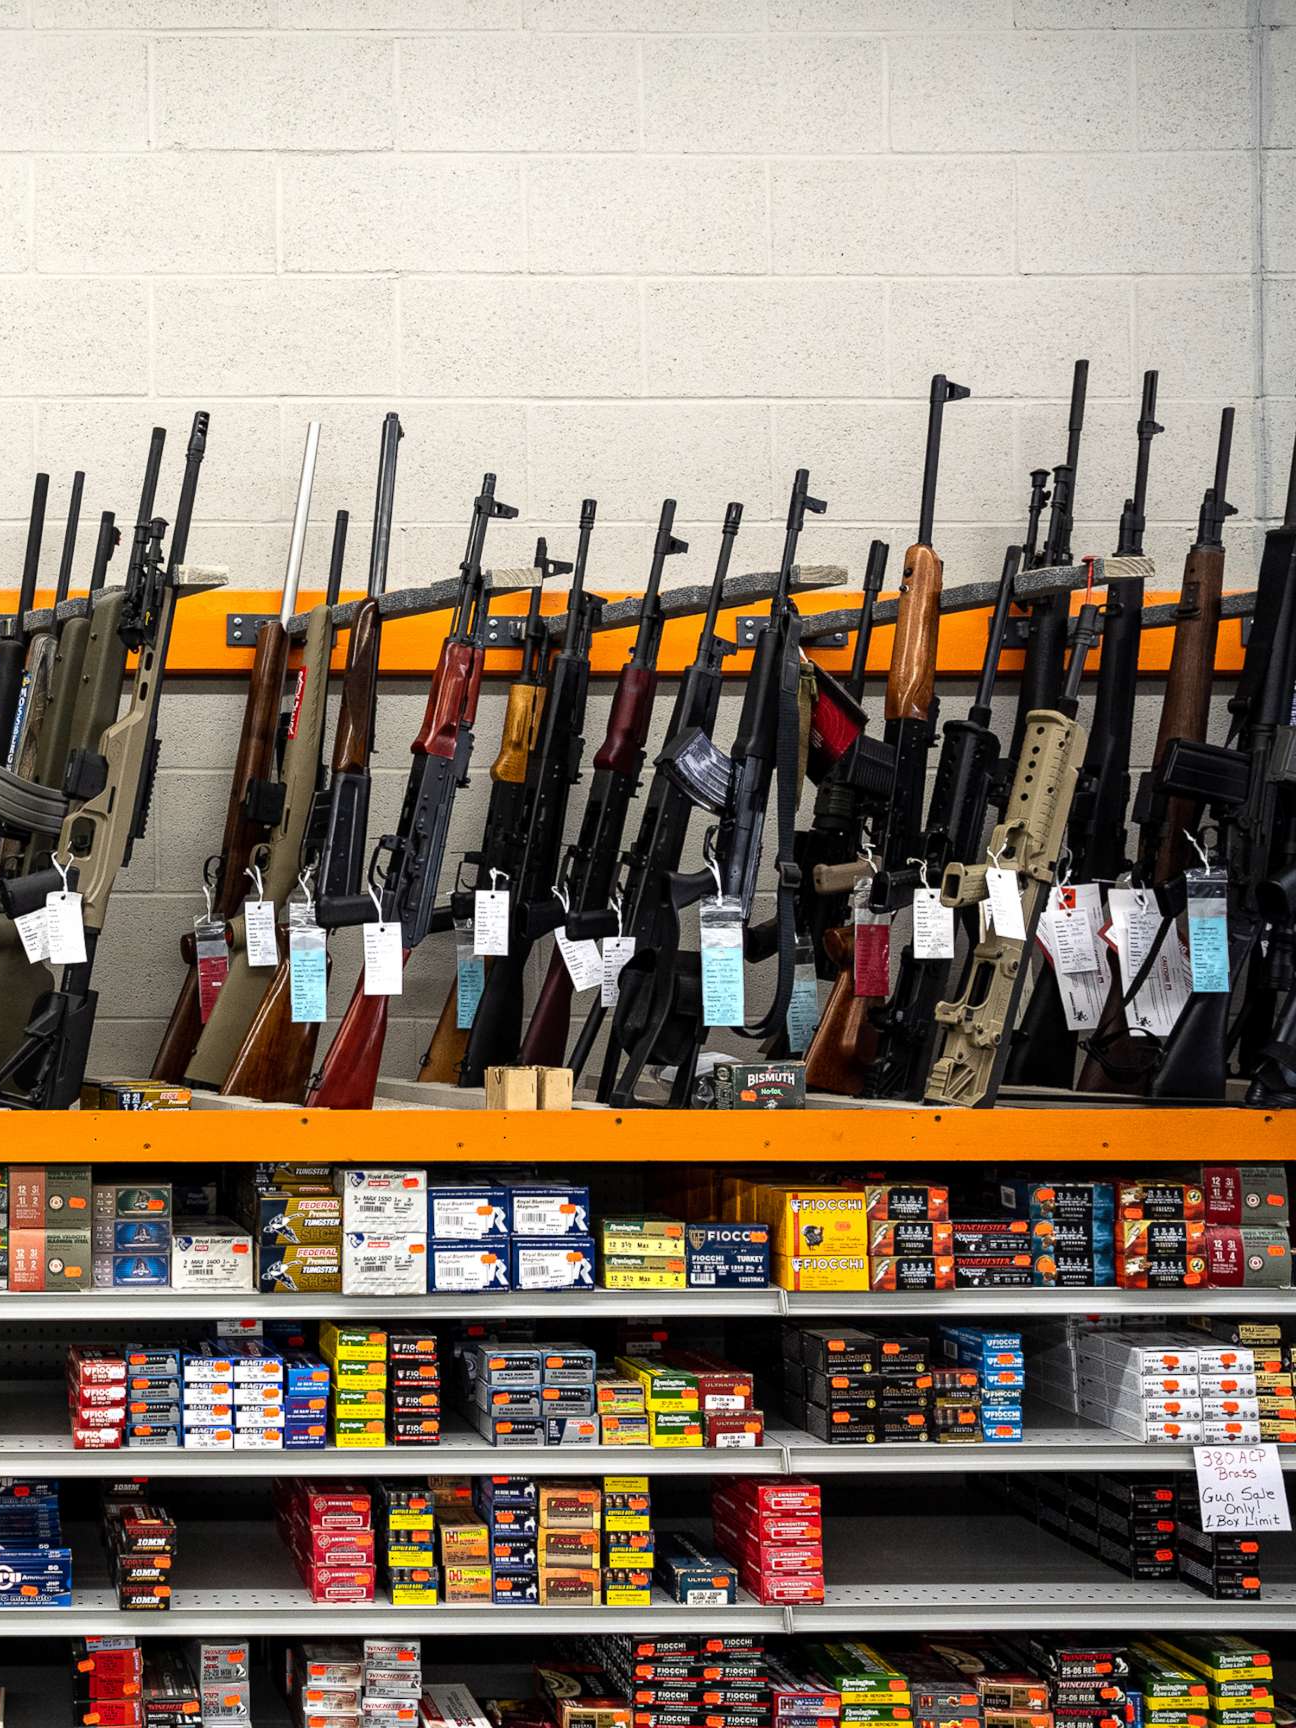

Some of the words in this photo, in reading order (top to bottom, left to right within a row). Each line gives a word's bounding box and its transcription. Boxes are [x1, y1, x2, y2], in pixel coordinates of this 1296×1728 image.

[748, 1073, 795, 1087] BISMUTH
[1211, 1177, 1220, 1186] 12
[18, 1185, 26, 1193] 12
[298, 1202, 338, 1210] FEDERAL
[802, 1200, 862, 1210] FIOCCHI
[610, 1224, 641, 1232] Remington
[708, 1231, 751, 1241] FIOCC
[1213, 1240, 1223, 1248] 12
[737, 1255, 764, 1263] TURKEY
[804, 1259, 864, 1270] FIOCCHI
[1202, 1451, 1234, 1467] 380
[1239, 1449, 1266, 1463] ACP
[1215, 1467, 1257, 1480] Brass
[1202, 1487, 1234, 1503] Gun
[1242, 1487, 1275, 1500] Sale
[1225, 1500, 1261, 1520] Only!
[1205, 1515, 1213, 1527] 1
[1217, 1515, 1239, 1527] Box
[1246, 1514, 1280, 1526] Limit
[137, 1538, 166, 1546] 10MM
[131, 1569, 160, 1577] 10MM
[724, 1639, 753, 1647] FIOCCHI
[1062, 1667, 1081, 1675] 25-06
